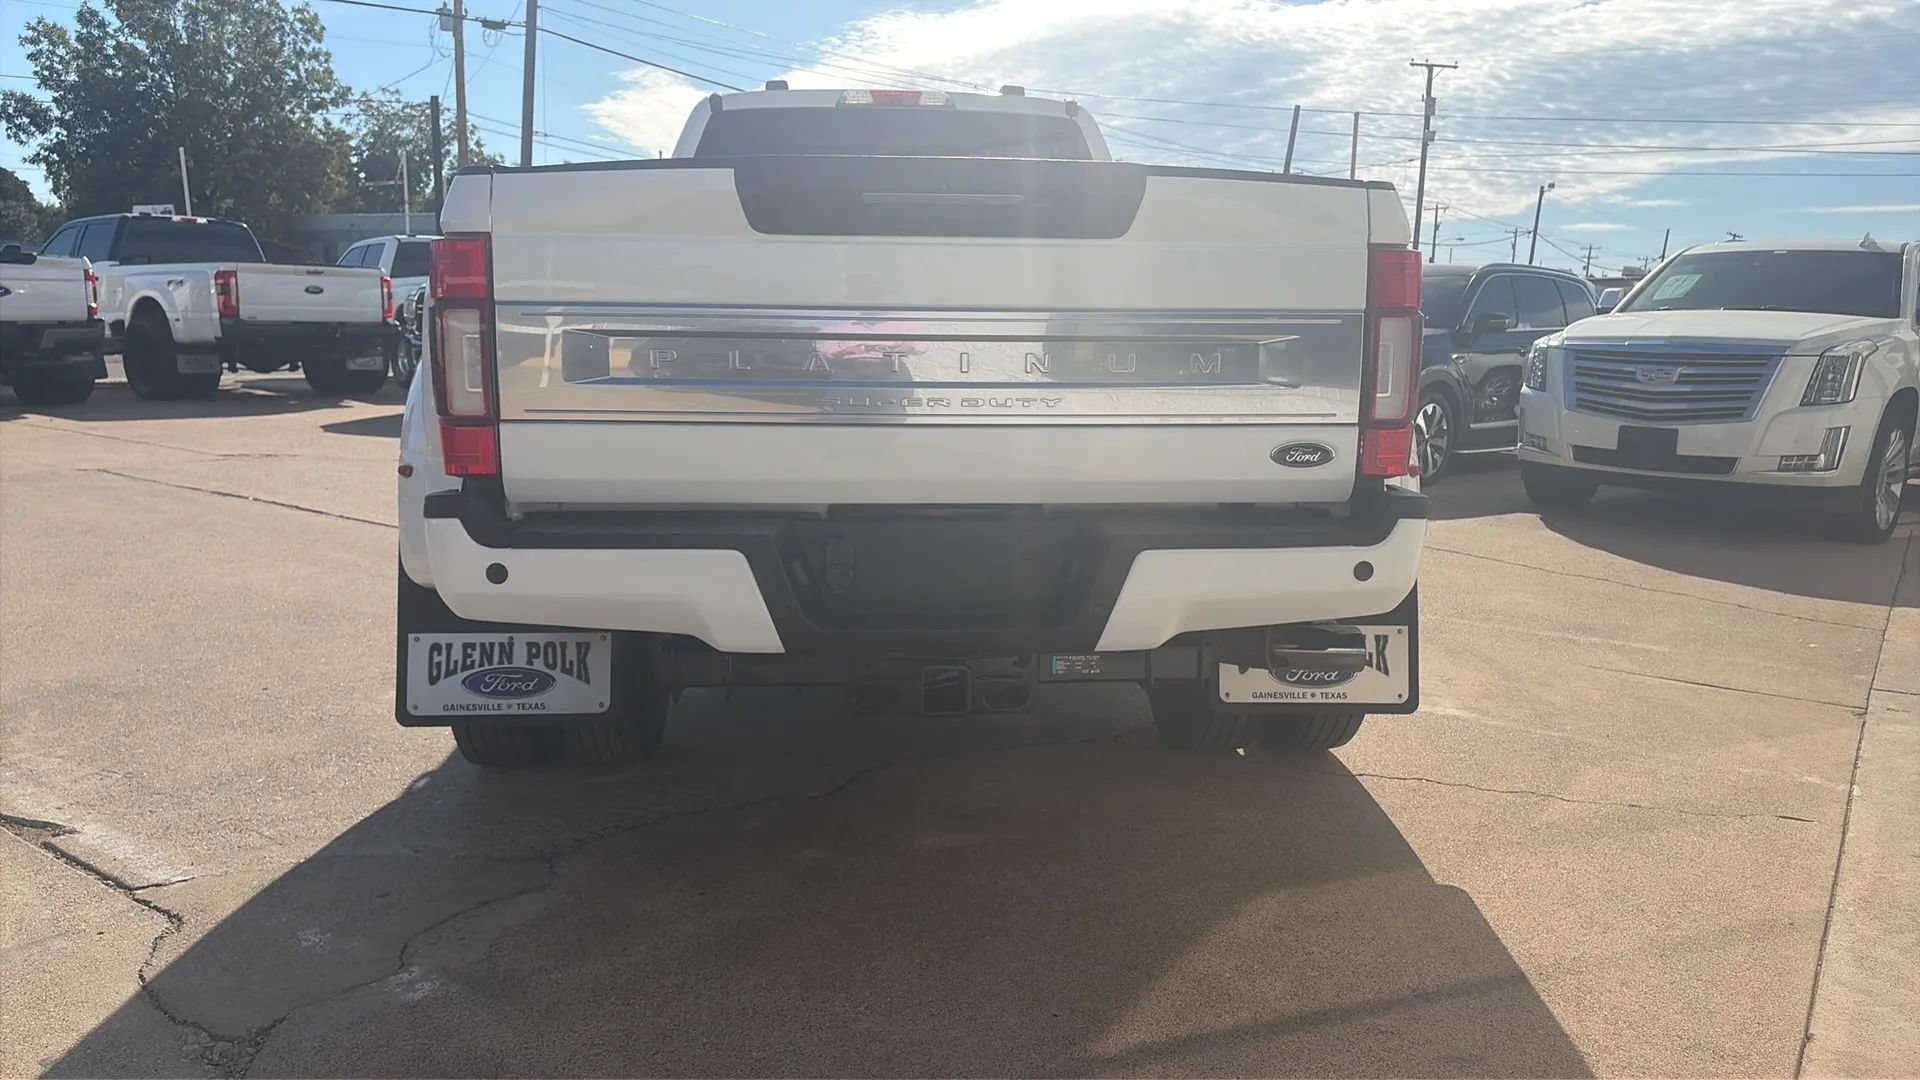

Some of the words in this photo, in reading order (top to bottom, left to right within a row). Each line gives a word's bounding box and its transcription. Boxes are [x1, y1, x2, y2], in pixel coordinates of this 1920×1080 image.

[649, 349, 1222, 374] PLATINUM
[960, 397, 1062, 409] DUTY
[1286, 446, 1321, 462] Ford
[427, 640, 516, 686] GLENN
[525, 641, 592, 686] POLK
[480, 673, 539, 693] Ford
[1251, 691, 1308, 700] GAINESVILLE
[1319, 691, 1348, 700] TEXAS
[442, 703, 503, 712] GAINESVILLE
[516, 702, 546, 711] TEXAS
